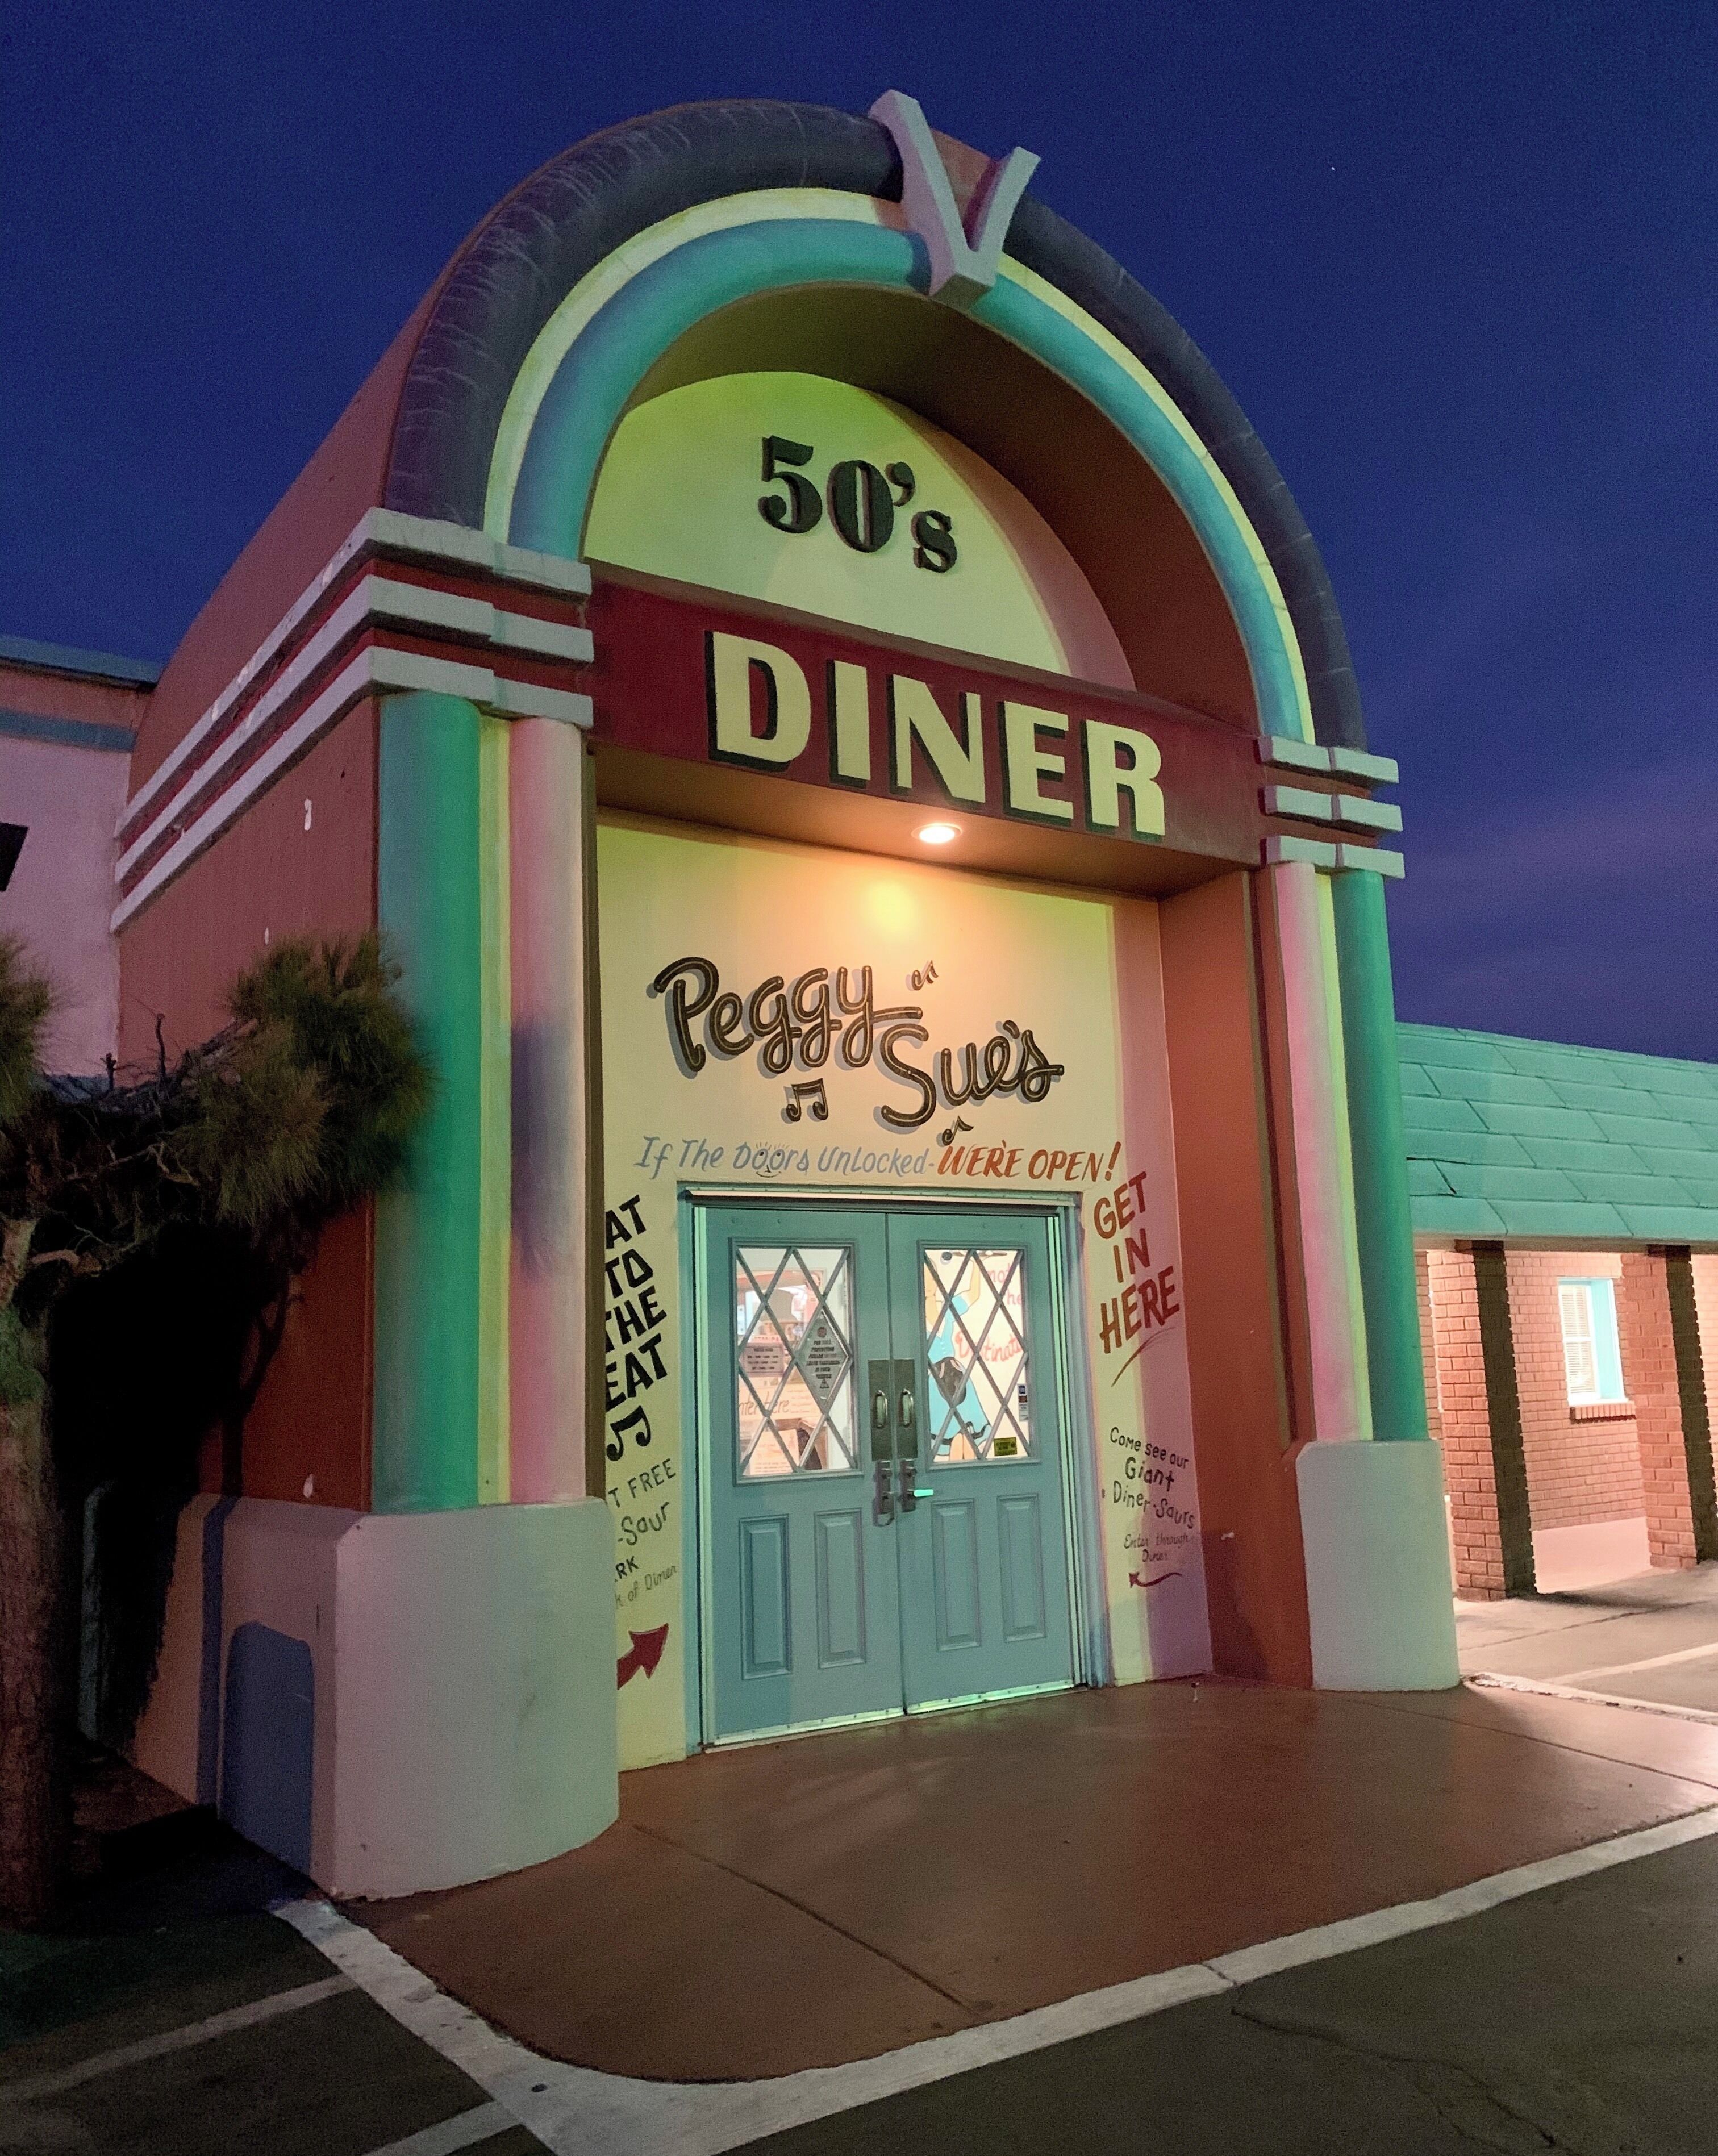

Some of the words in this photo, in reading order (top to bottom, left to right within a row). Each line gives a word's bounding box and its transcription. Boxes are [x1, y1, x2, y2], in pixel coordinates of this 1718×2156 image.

[758, 435, 958, 573] 50's
[704, 629, 1166, 841] DINER
[653, 956, 923, 1075] Peggy
[881, 1020, 1065, 1128] Sue's
[634, 1136, 673, 1180] If
[679, 1137, 724, 1171] The
[1028, 1141, 1121, 1182] OPEN!
[606, 1194, 647, 1249] AT
[1094, 1171, 1147, 1240] GET
[605, 1249, 653, 1299] TO
[1113, 1228, 1150, 1283] IN
[1099, 1266, 1180, 1354] HERE
[608, 1487, 620, 1508] T
[627, 1458, 676, 1499] FREE
[1125, 1457, 1174, 1492] Giant
[1169, 1453, 1189, 1469] our
[615, 1556, 639, 1582] RK
[645, 1565, 677, 1590] Diner
